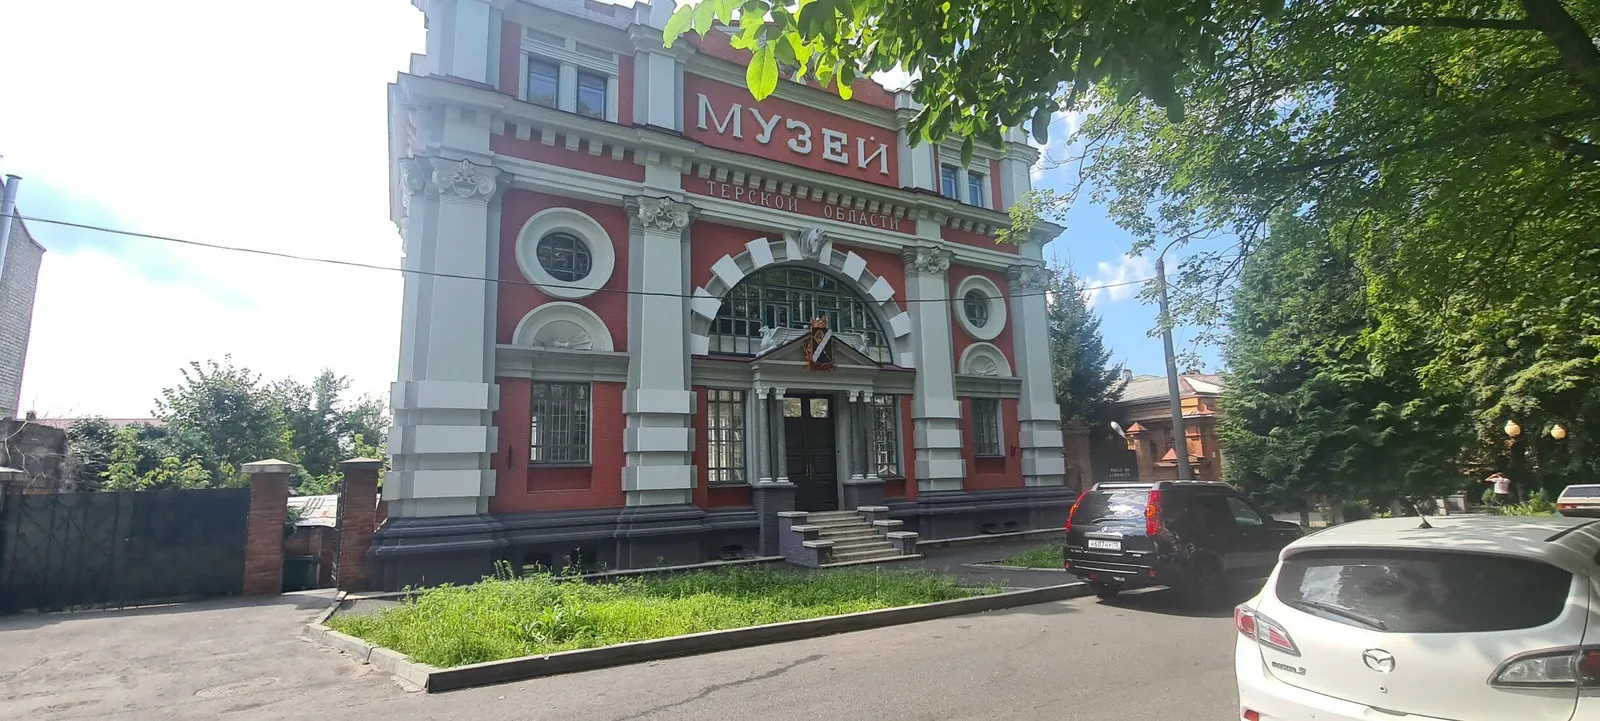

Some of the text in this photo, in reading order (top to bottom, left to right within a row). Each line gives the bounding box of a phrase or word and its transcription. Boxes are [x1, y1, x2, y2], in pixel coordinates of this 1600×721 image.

[696, 92, 890, 175] МУЗЕЙ
[706, 180, 901, 231] ТЕРСКОЙ ОБЛАСТИ
